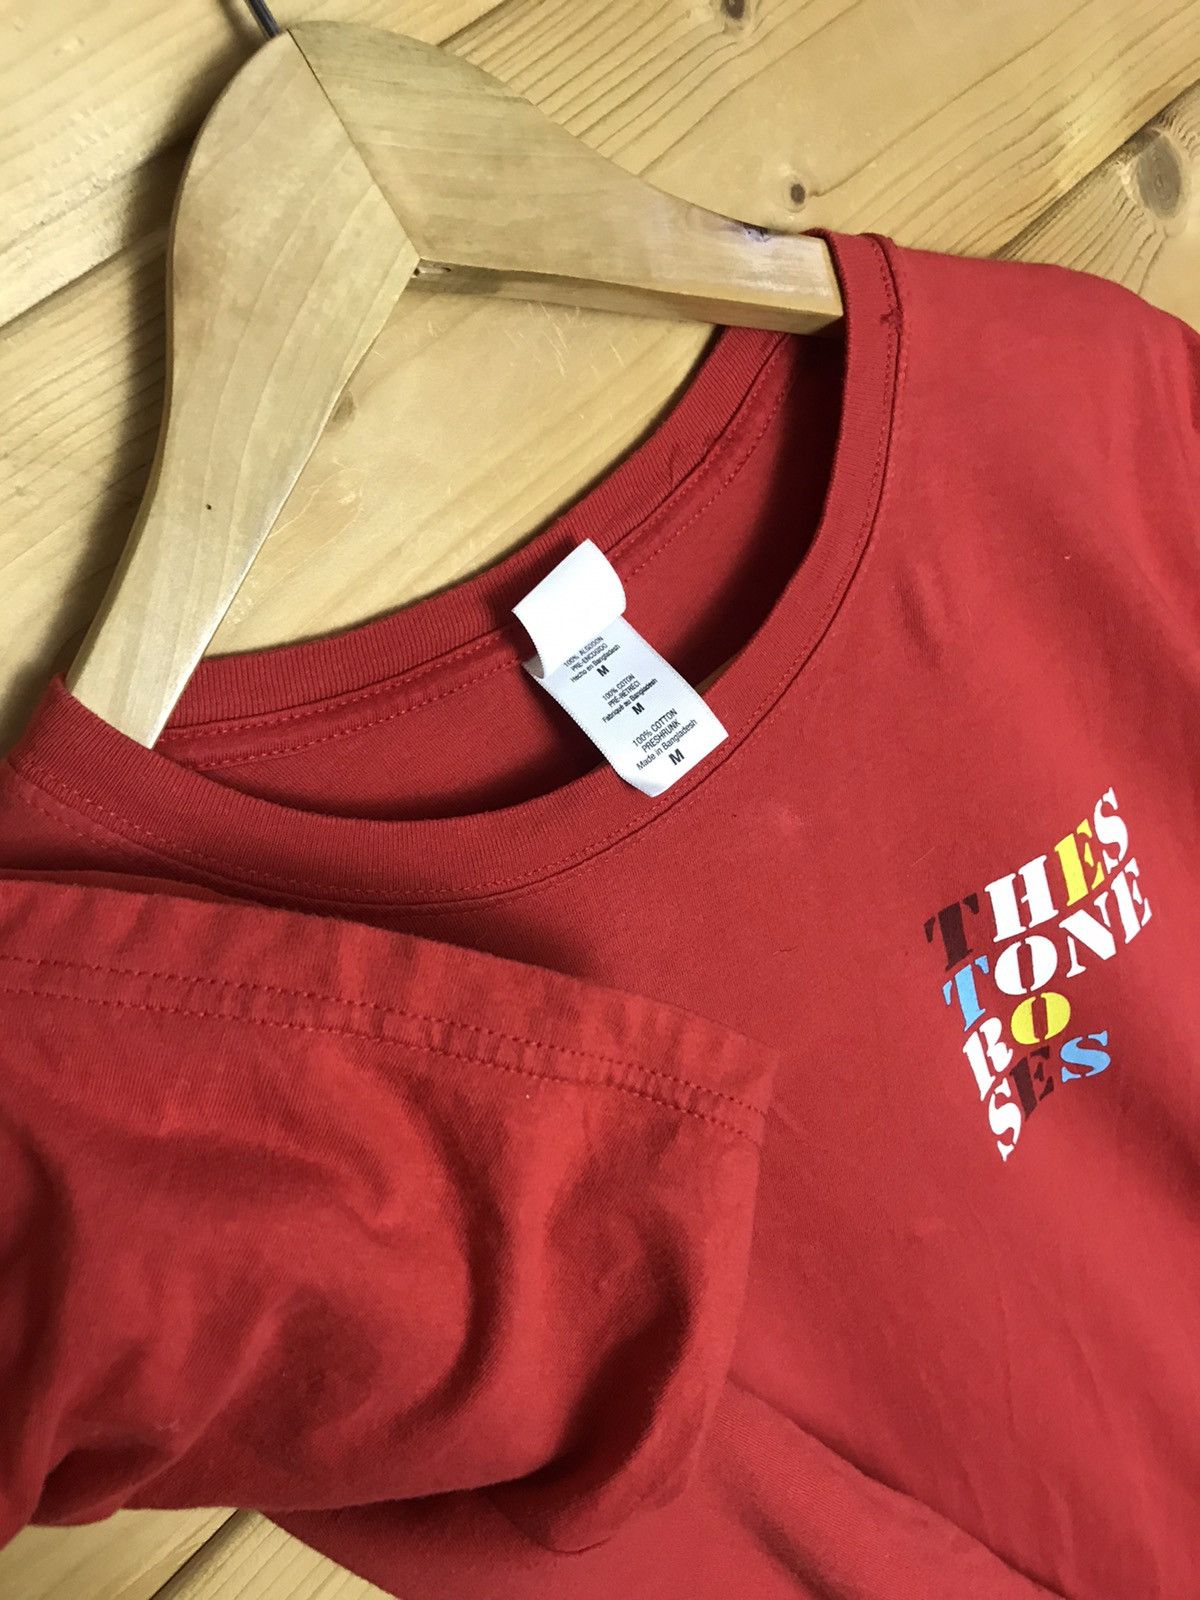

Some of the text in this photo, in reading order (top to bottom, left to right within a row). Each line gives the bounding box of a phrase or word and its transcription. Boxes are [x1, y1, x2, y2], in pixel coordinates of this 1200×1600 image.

[592, 644, 621, 667] Bangladesh
[596, 664, 610, 677] M
[602, 673, 635, 701] 100% COTON
[629, 678, 658, 701] Bangladesh
[631, 702, 645, 715] M
[632, 708, 678, 747] 100% COTTON
[641, 718, 681, 753] PRESHRUNK
[636, 719, 698, 770] Made in Bangladesh
[668, 748, 685, 766] M
